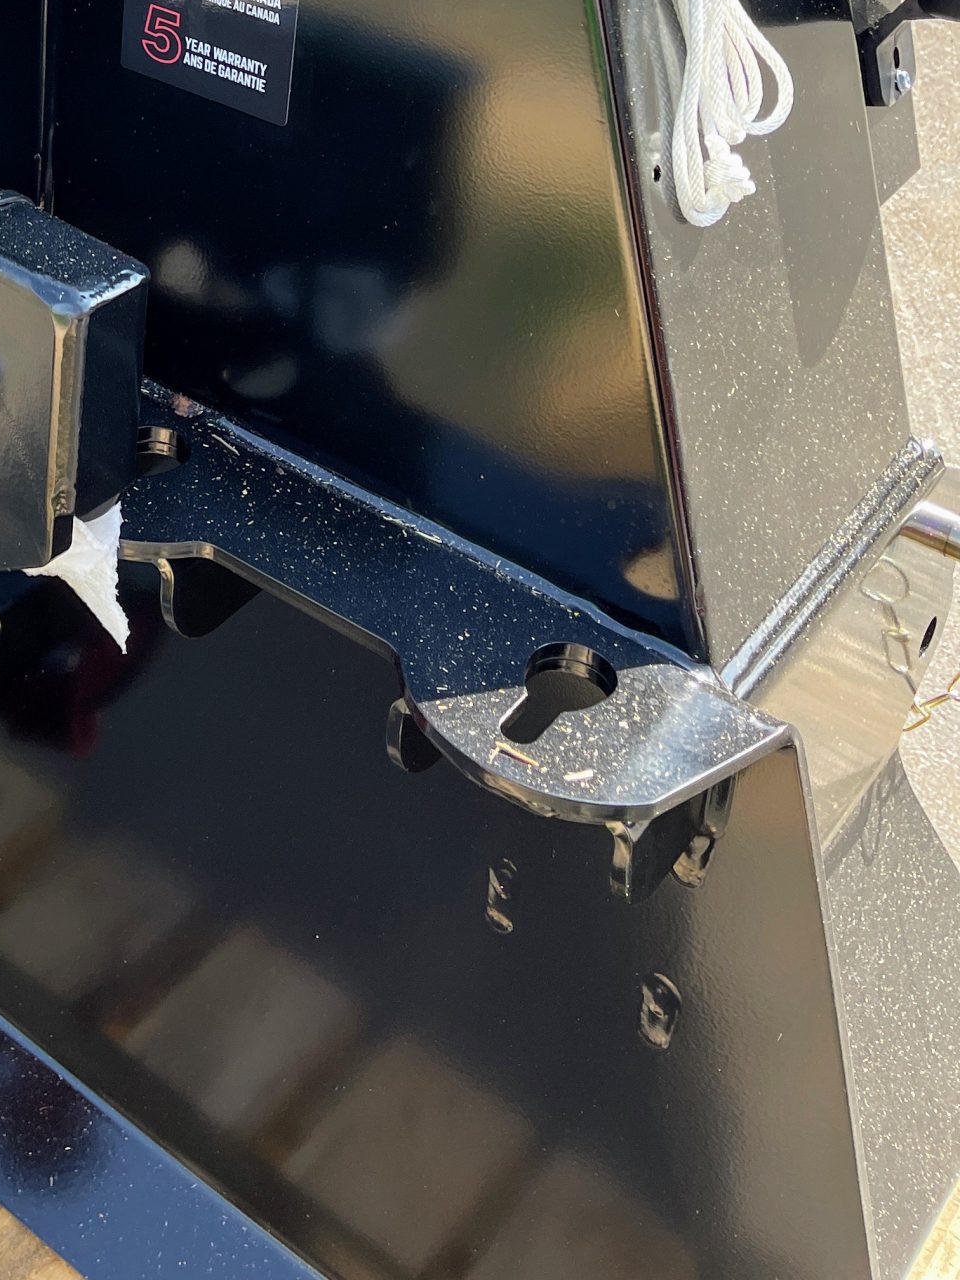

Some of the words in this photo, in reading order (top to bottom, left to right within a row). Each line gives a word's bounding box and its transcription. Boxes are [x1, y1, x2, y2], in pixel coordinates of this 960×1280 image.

[233, 0, 246, 13] AU
[246, 3, 280, 25] CANADA
[142, 3, 182, 64] 5
[183, 51, 204, 70] ANS
[204, 59, 218, 76] DE
[217, 64, 267, 93] GARANTIE
[184, 36, 212, 57] YEAR
[213, 46, 268, 77] WARRANTY
